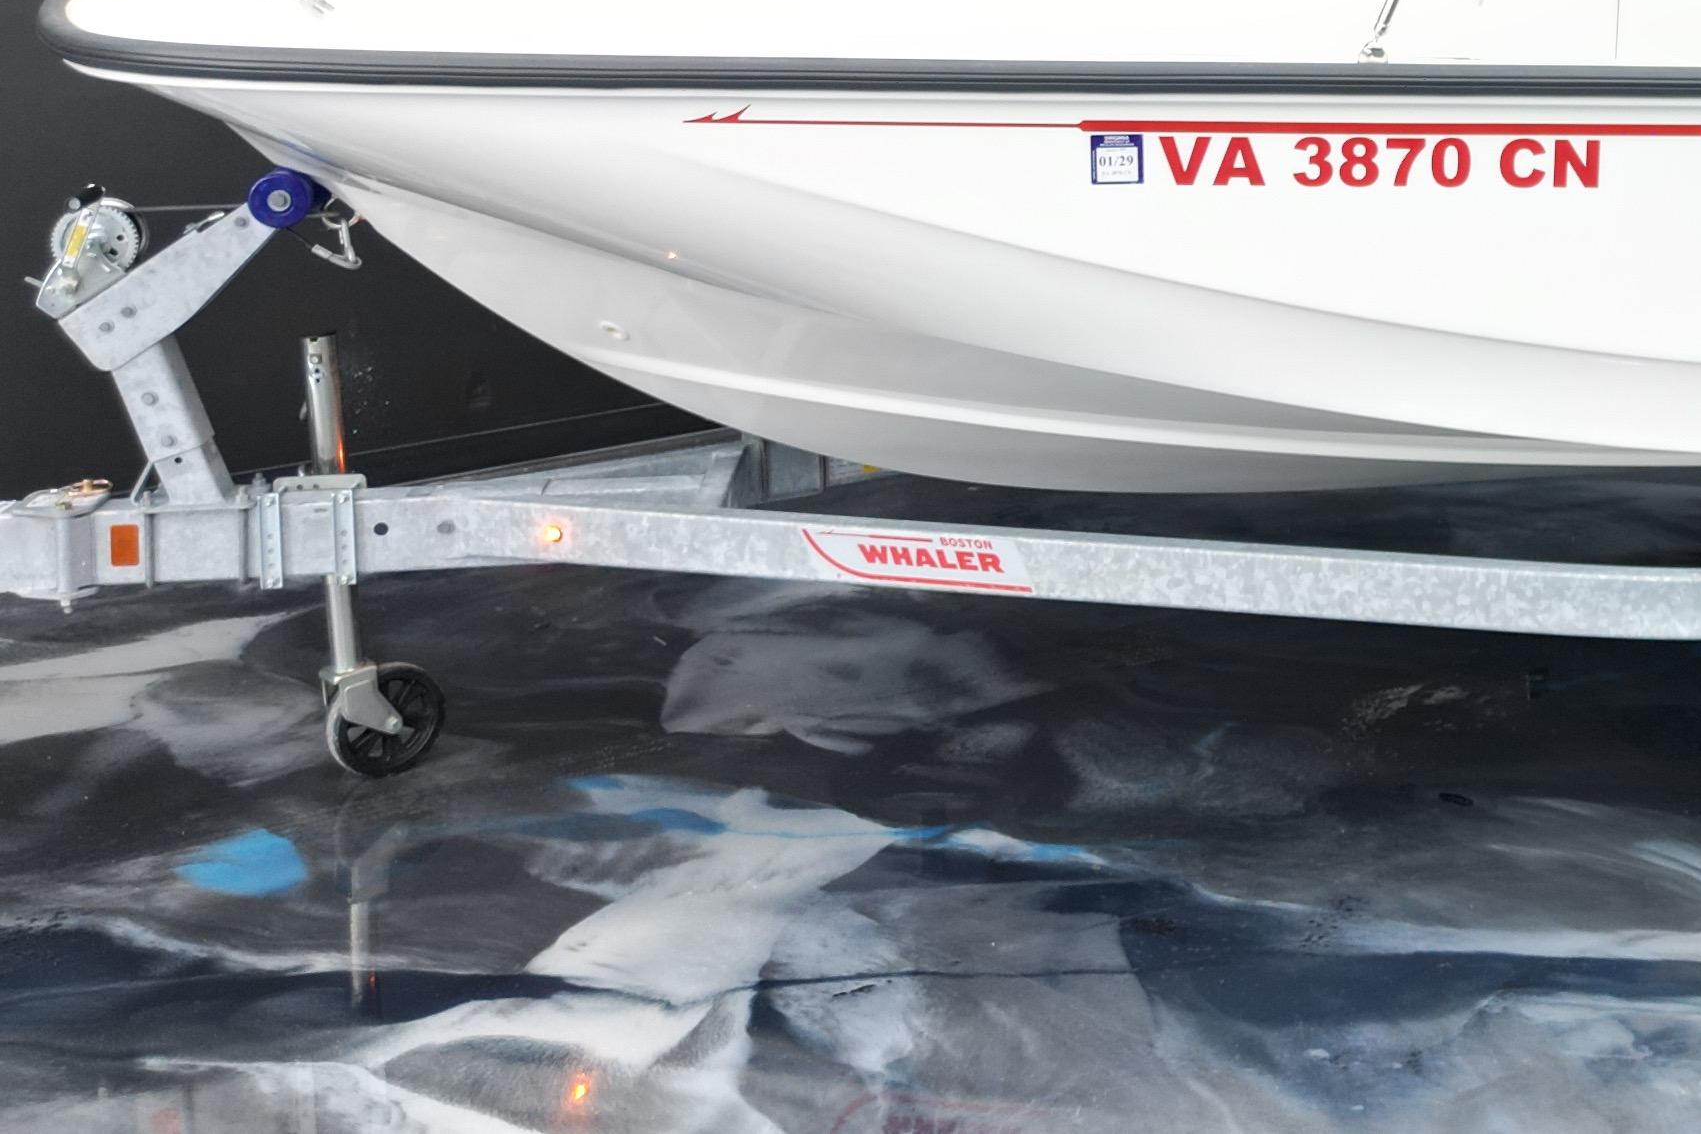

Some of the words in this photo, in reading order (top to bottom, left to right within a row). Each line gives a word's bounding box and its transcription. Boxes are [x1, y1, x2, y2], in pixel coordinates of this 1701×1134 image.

[1159, 136, 1266, 186] VA
[1293, 136, 1472, 187] 3870
[1500, 138, 1600, 188] CN
[857, 543, 1005, 573] WHALER
[940, 536, 993, 550] BOSTON
